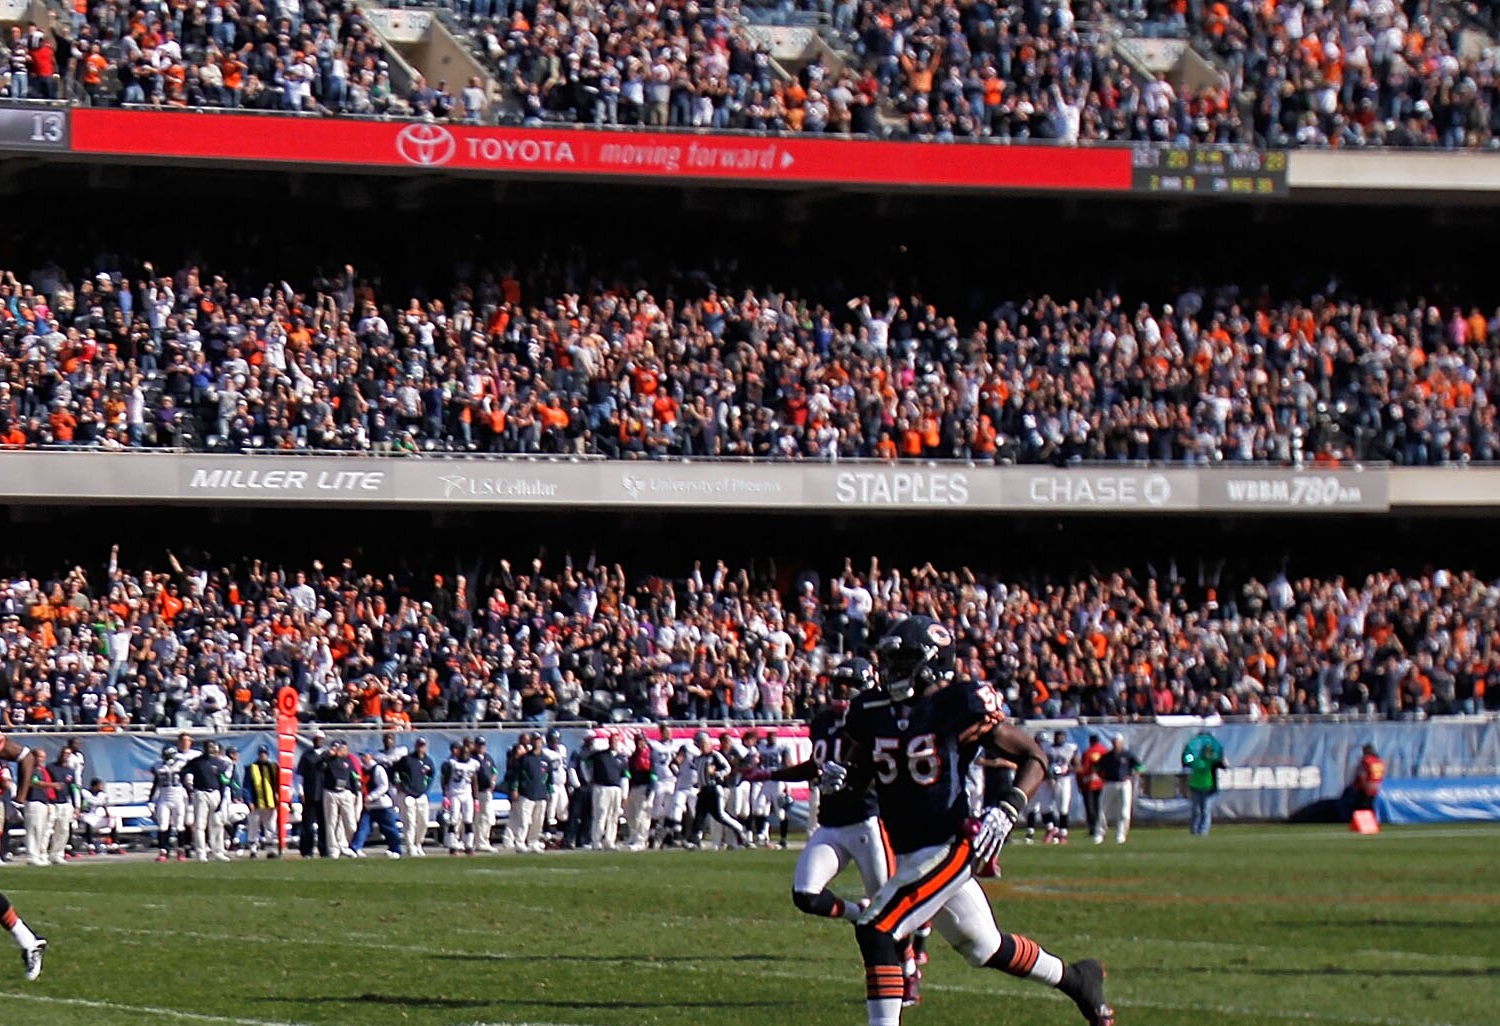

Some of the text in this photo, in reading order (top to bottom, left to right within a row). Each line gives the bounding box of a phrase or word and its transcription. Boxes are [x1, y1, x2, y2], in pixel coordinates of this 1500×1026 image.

[30, 113, 64, 142] 13
[465, 137, 775, 171] TOYOTA moving forward
[190, 469, 384, 490] MILLER LITE
[836, 472, 969, 504] STAPLES
[1029, 476, 1138, 503] CHASE
[1227, 479, 1289, 501] WBBM
